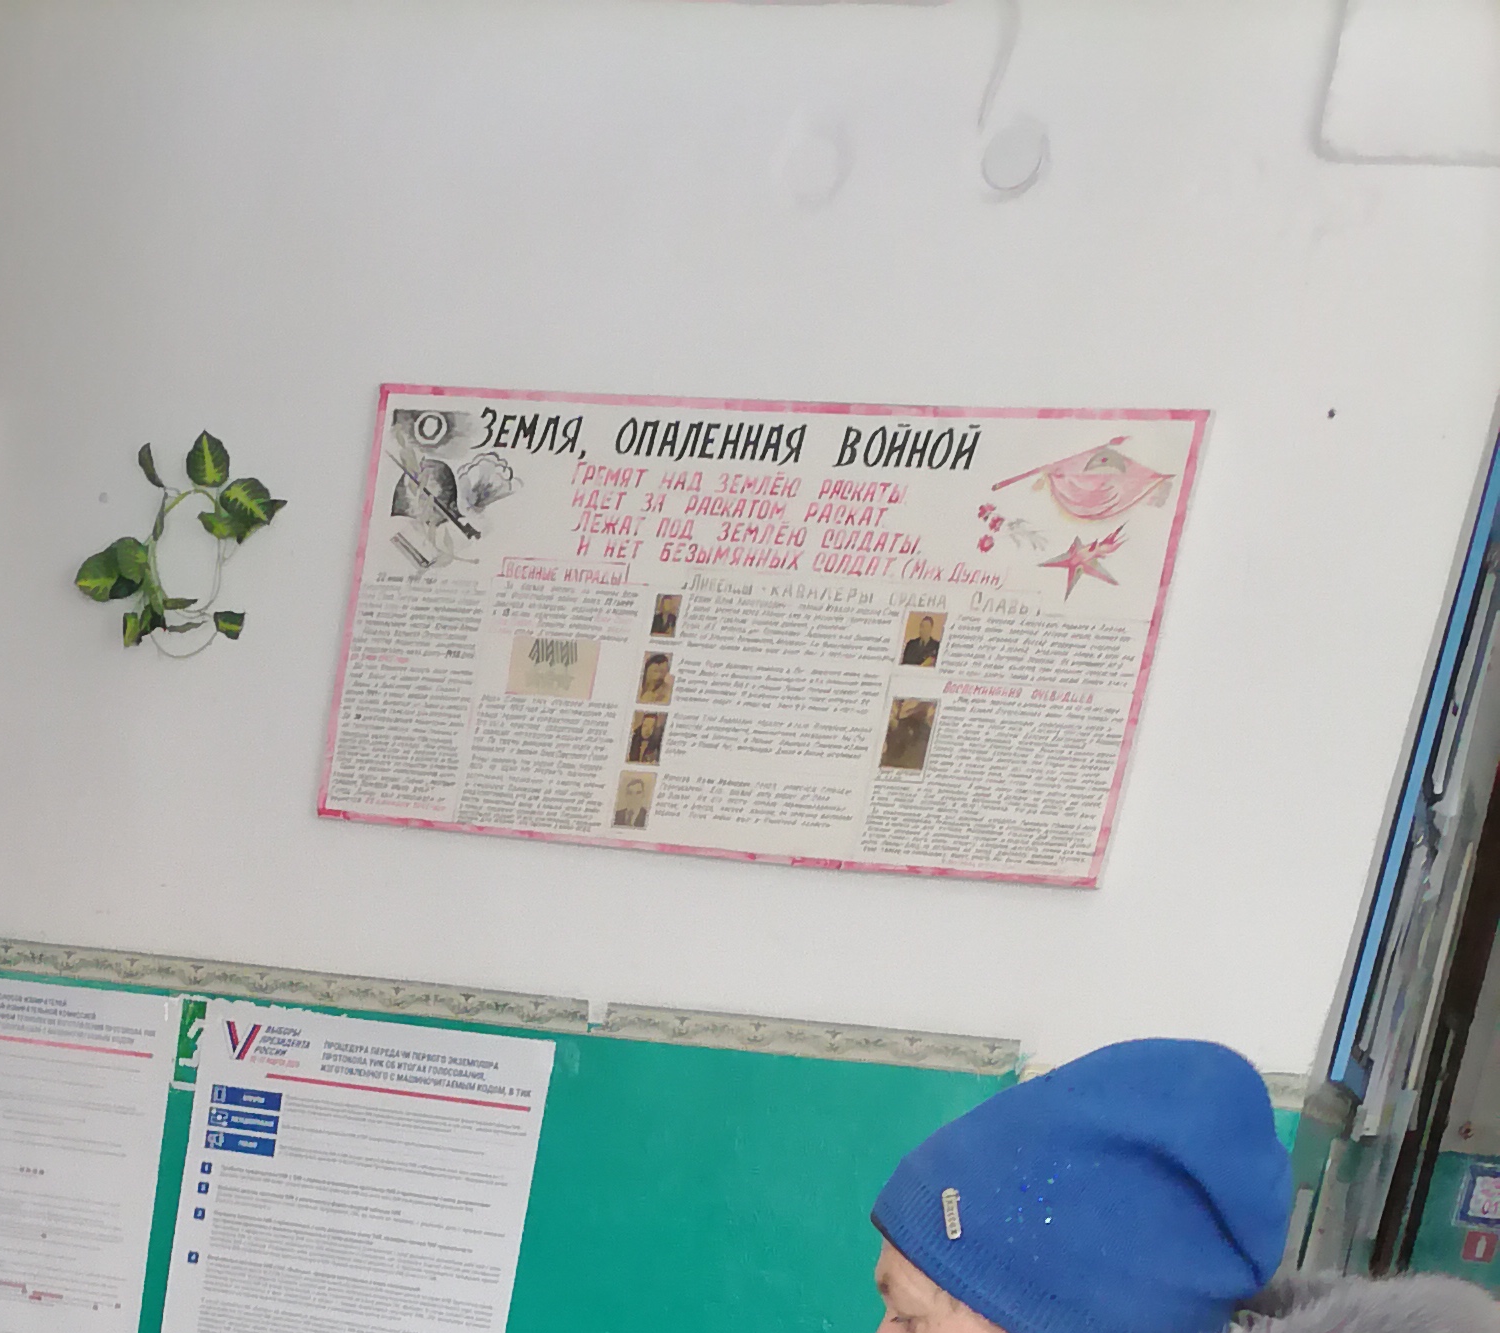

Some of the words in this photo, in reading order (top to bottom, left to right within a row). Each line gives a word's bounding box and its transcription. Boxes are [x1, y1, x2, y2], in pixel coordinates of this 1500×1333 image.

[471, 407, 587, 460] ЗЕМЛЯ,
[616, 417, 806, 466] ОПАЛЕННАЯ
[834, 423, 982, 471] ВОЙНОЙ
